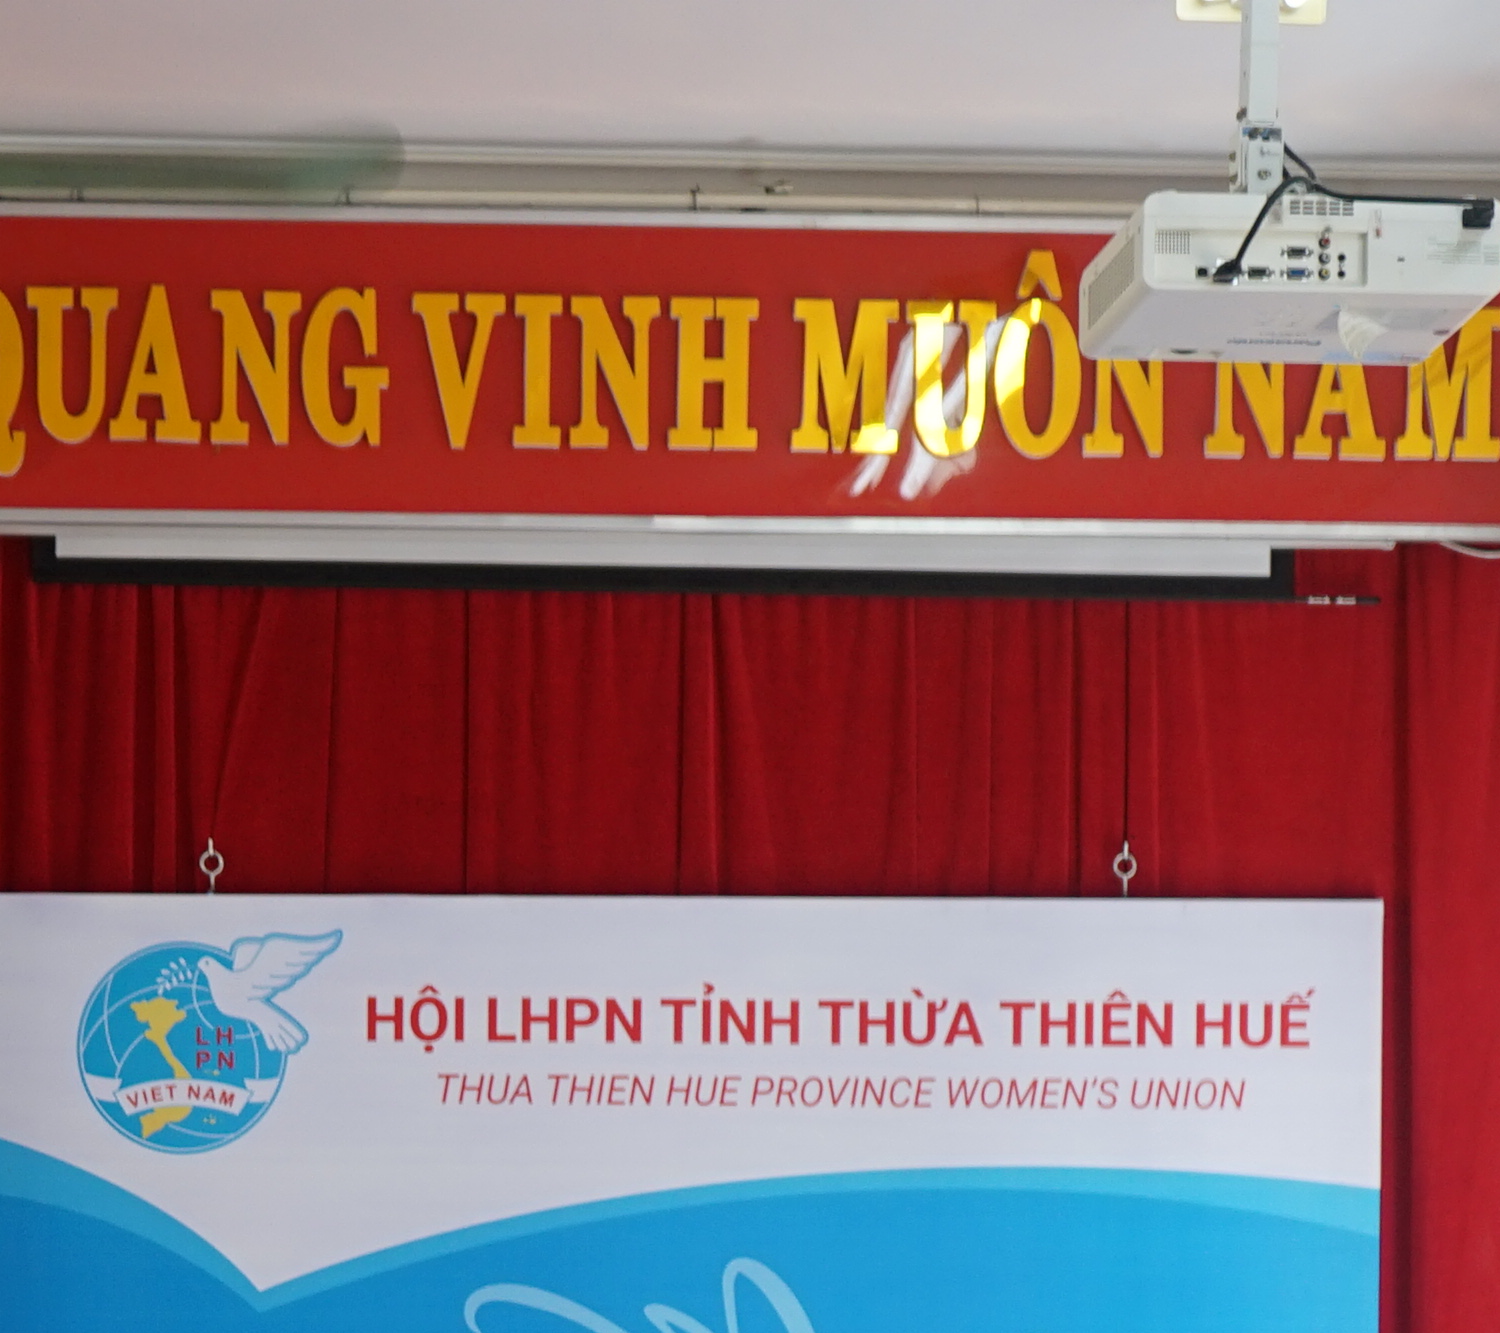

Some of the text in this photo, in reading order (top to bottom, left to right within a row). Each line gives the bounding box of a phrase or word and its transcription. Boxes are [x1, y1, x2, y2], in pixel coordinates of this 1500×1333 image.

[412, 291, 761, 454] VINH
[790, 251, 1165, 460] MUÔN
[366, 982, 1315, 1054] HỘI LHPN TỈNH THỪA THIÊN HUẾ
[186, 1084, 236, 1108] NAM
[438, 1072, 533, 1106] THUA
[548, 1074, 657, 1107] THIEN
[665, 1075, 740, 1108] HUE
[750, 1076, 934, 1109] PROVINCE
[1130, 1079, 1247, 1110] UNION
